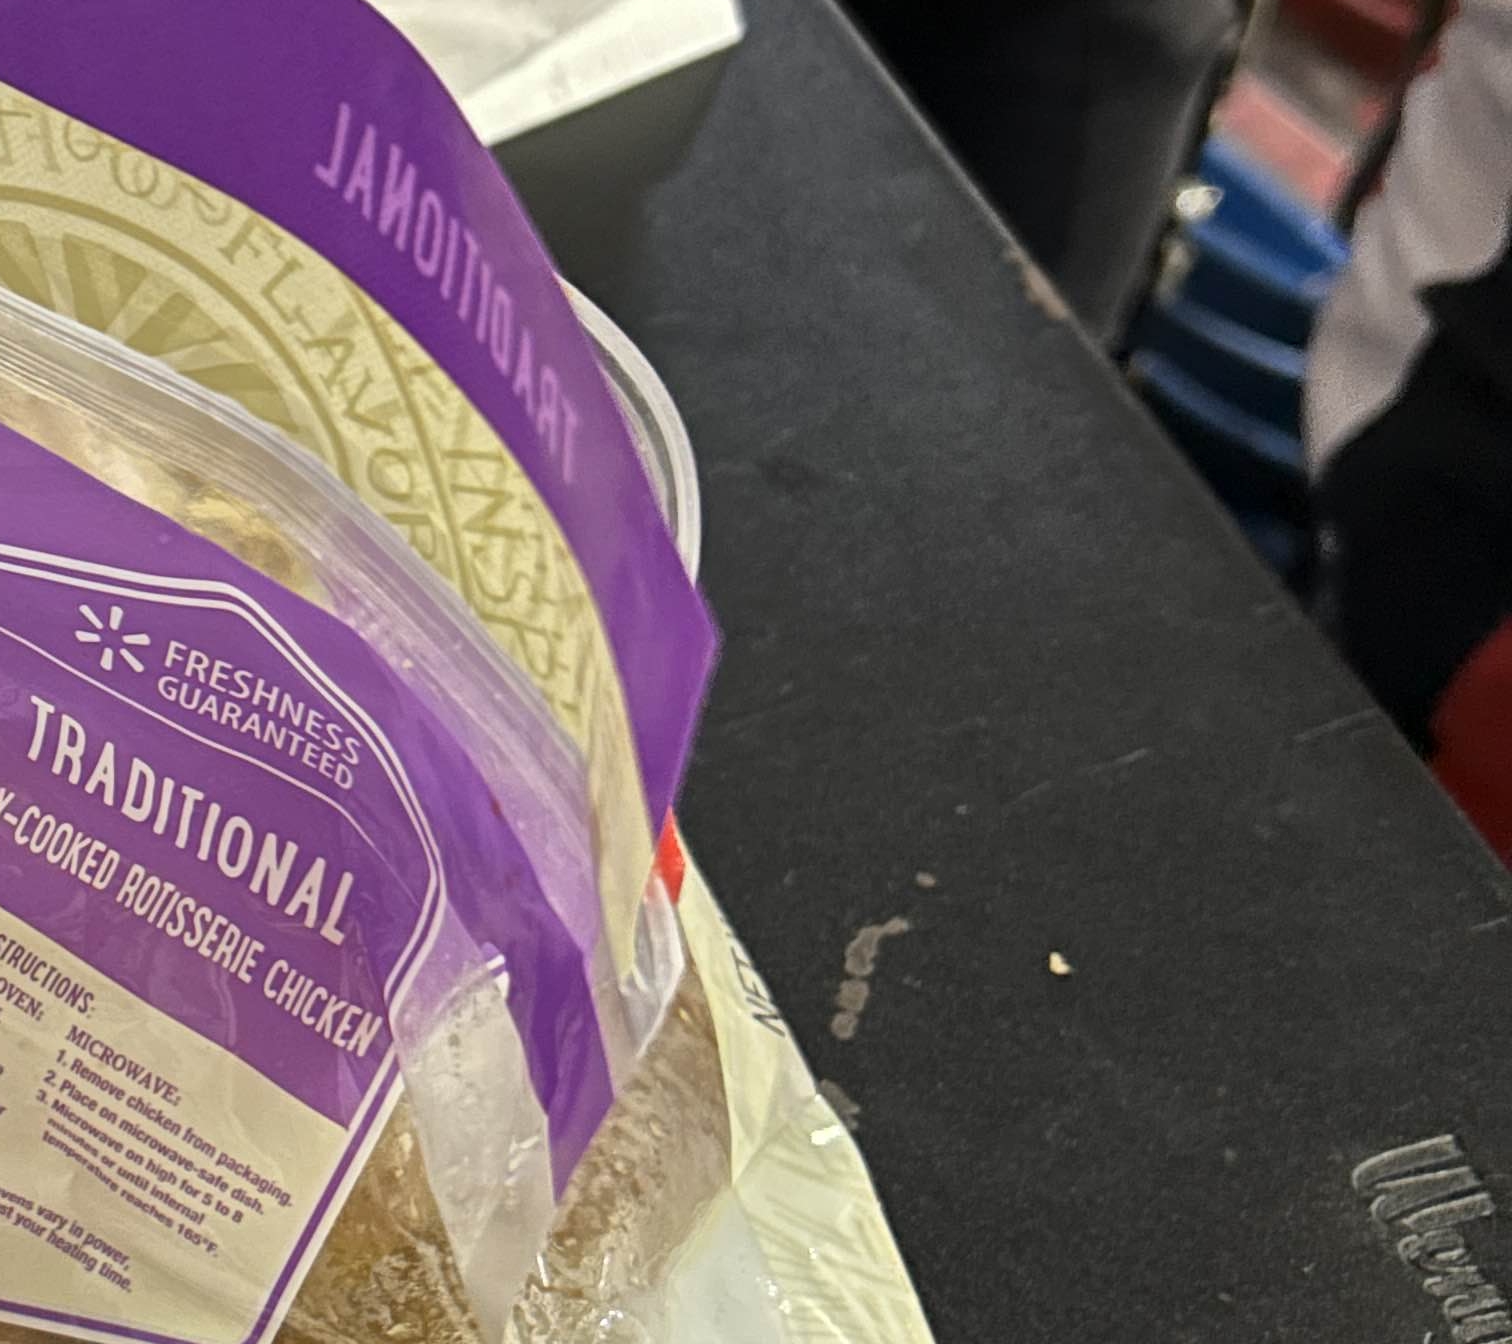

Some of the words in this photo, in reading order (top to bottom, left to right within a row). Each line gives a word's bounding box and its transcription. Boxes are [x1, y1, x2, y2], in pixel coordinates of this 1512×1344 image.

[157, 675, 356, 791] GUARANTEED
[164, 640, 361, 767] FRESHNESS
[26, 694, 355, 946] TRADITIONAL
[115, 862, 264, 986] ROTISSERIE
[261, 958, 385, 1059] CHICKEN
[65, 1024, 182, 1106] MICROWAVE:
[36, 1088, 49, 1105] 3.
[51, 1099, 124, 1154] Microwave
[126, 1148, 145, 1164] on
[146, 1158, 179, 1186] high
[179, 1180, 202, 1199] for
[214, 1200, 229, 1216] to
[42, 1130, 119, 1193] temperature
[120, 1189, 175, 1228] reaches
[43, 1070, 56, 1087] 2.
[59, 1079, 98, 1111] Place
[99, 1106, 118, 1124] on
[119, 1119, 229, 1192] microwave-safe
[230, 1187, 265, 1215] dish.
[46, 1117, 100, 1157] minutes
[100, 1155, 116, 1168] or
[116, 1165, 149, 1192] until
[150, 1185, 206, 1225] internal
[55, 1049, 68, 1067] 1.
[70, 1058, 126, 1101] Remove
[126, 1094, 182, 1136] chicken
[182, 1127, 216, 1158] from
[216, 1152, 293, 1207] packaging.
[12, 1213, 47, 1238] your
[46, 1229, 98, 1272] heating
[98, 1262, 133, 1293] time.
[36, 1205, 68, 1231] vary
[68, 1219, 84, 1238] in
[82, 1233, 131, 1271] power,
